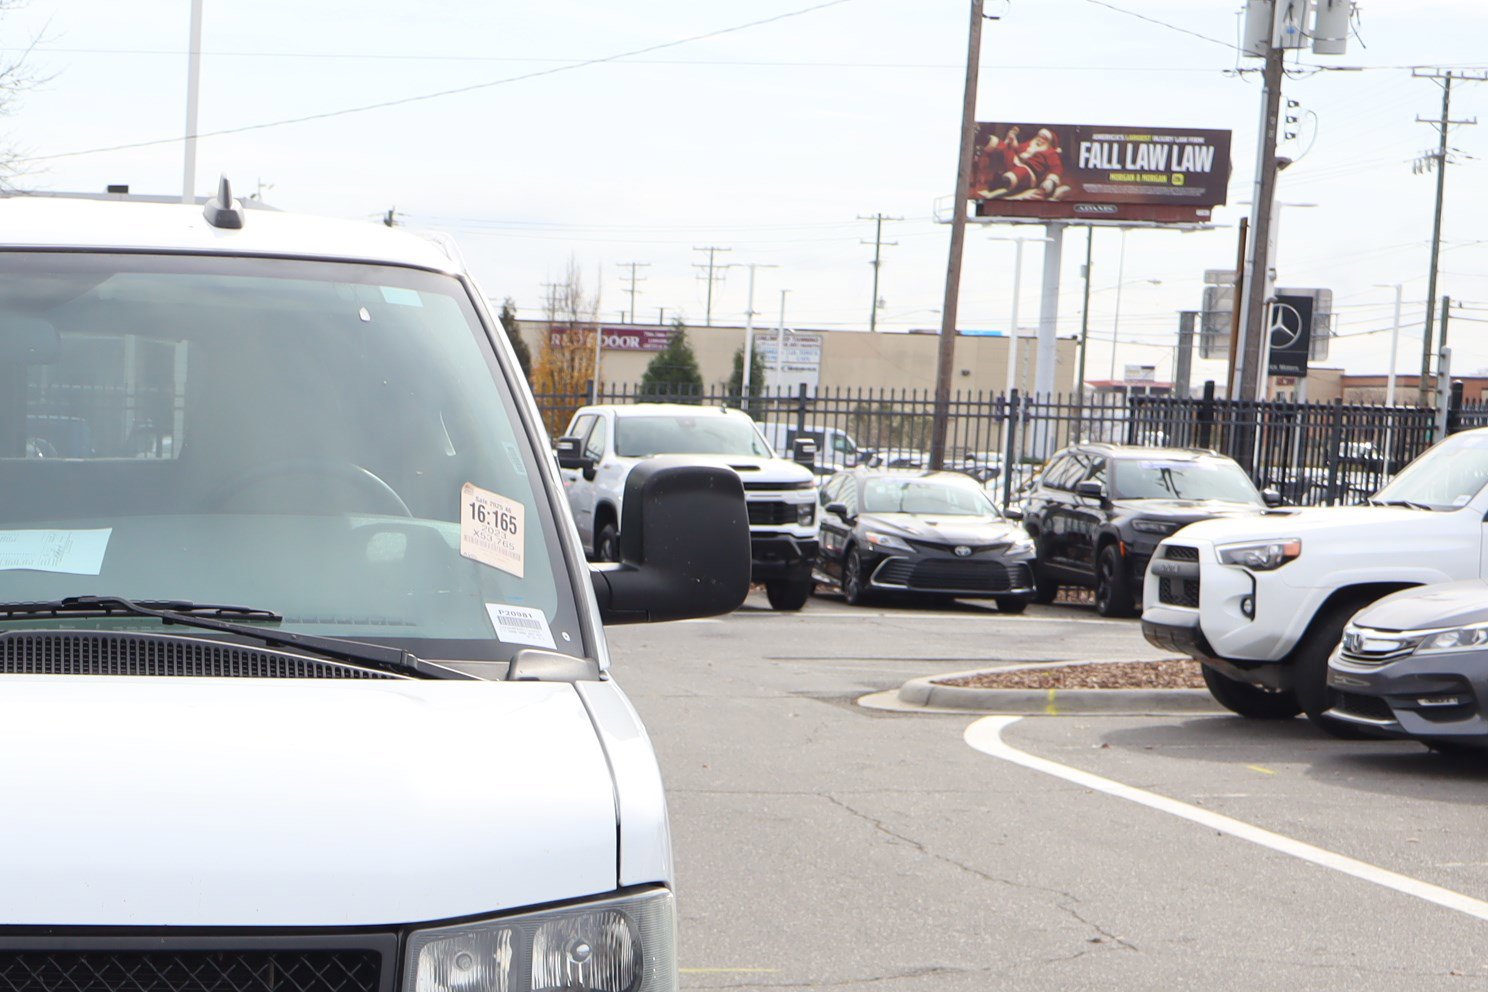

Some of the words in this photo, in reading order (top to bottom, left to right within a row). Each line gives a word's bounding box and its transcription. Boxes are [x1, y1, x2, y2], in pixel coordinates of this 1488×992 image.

[1078, 141, 1122, 170] FALL
[1125, 143, 1169, 171] LAW
[1171, 144, 1215, 173] LAW
[469, 502, 517, 535] 16:165
